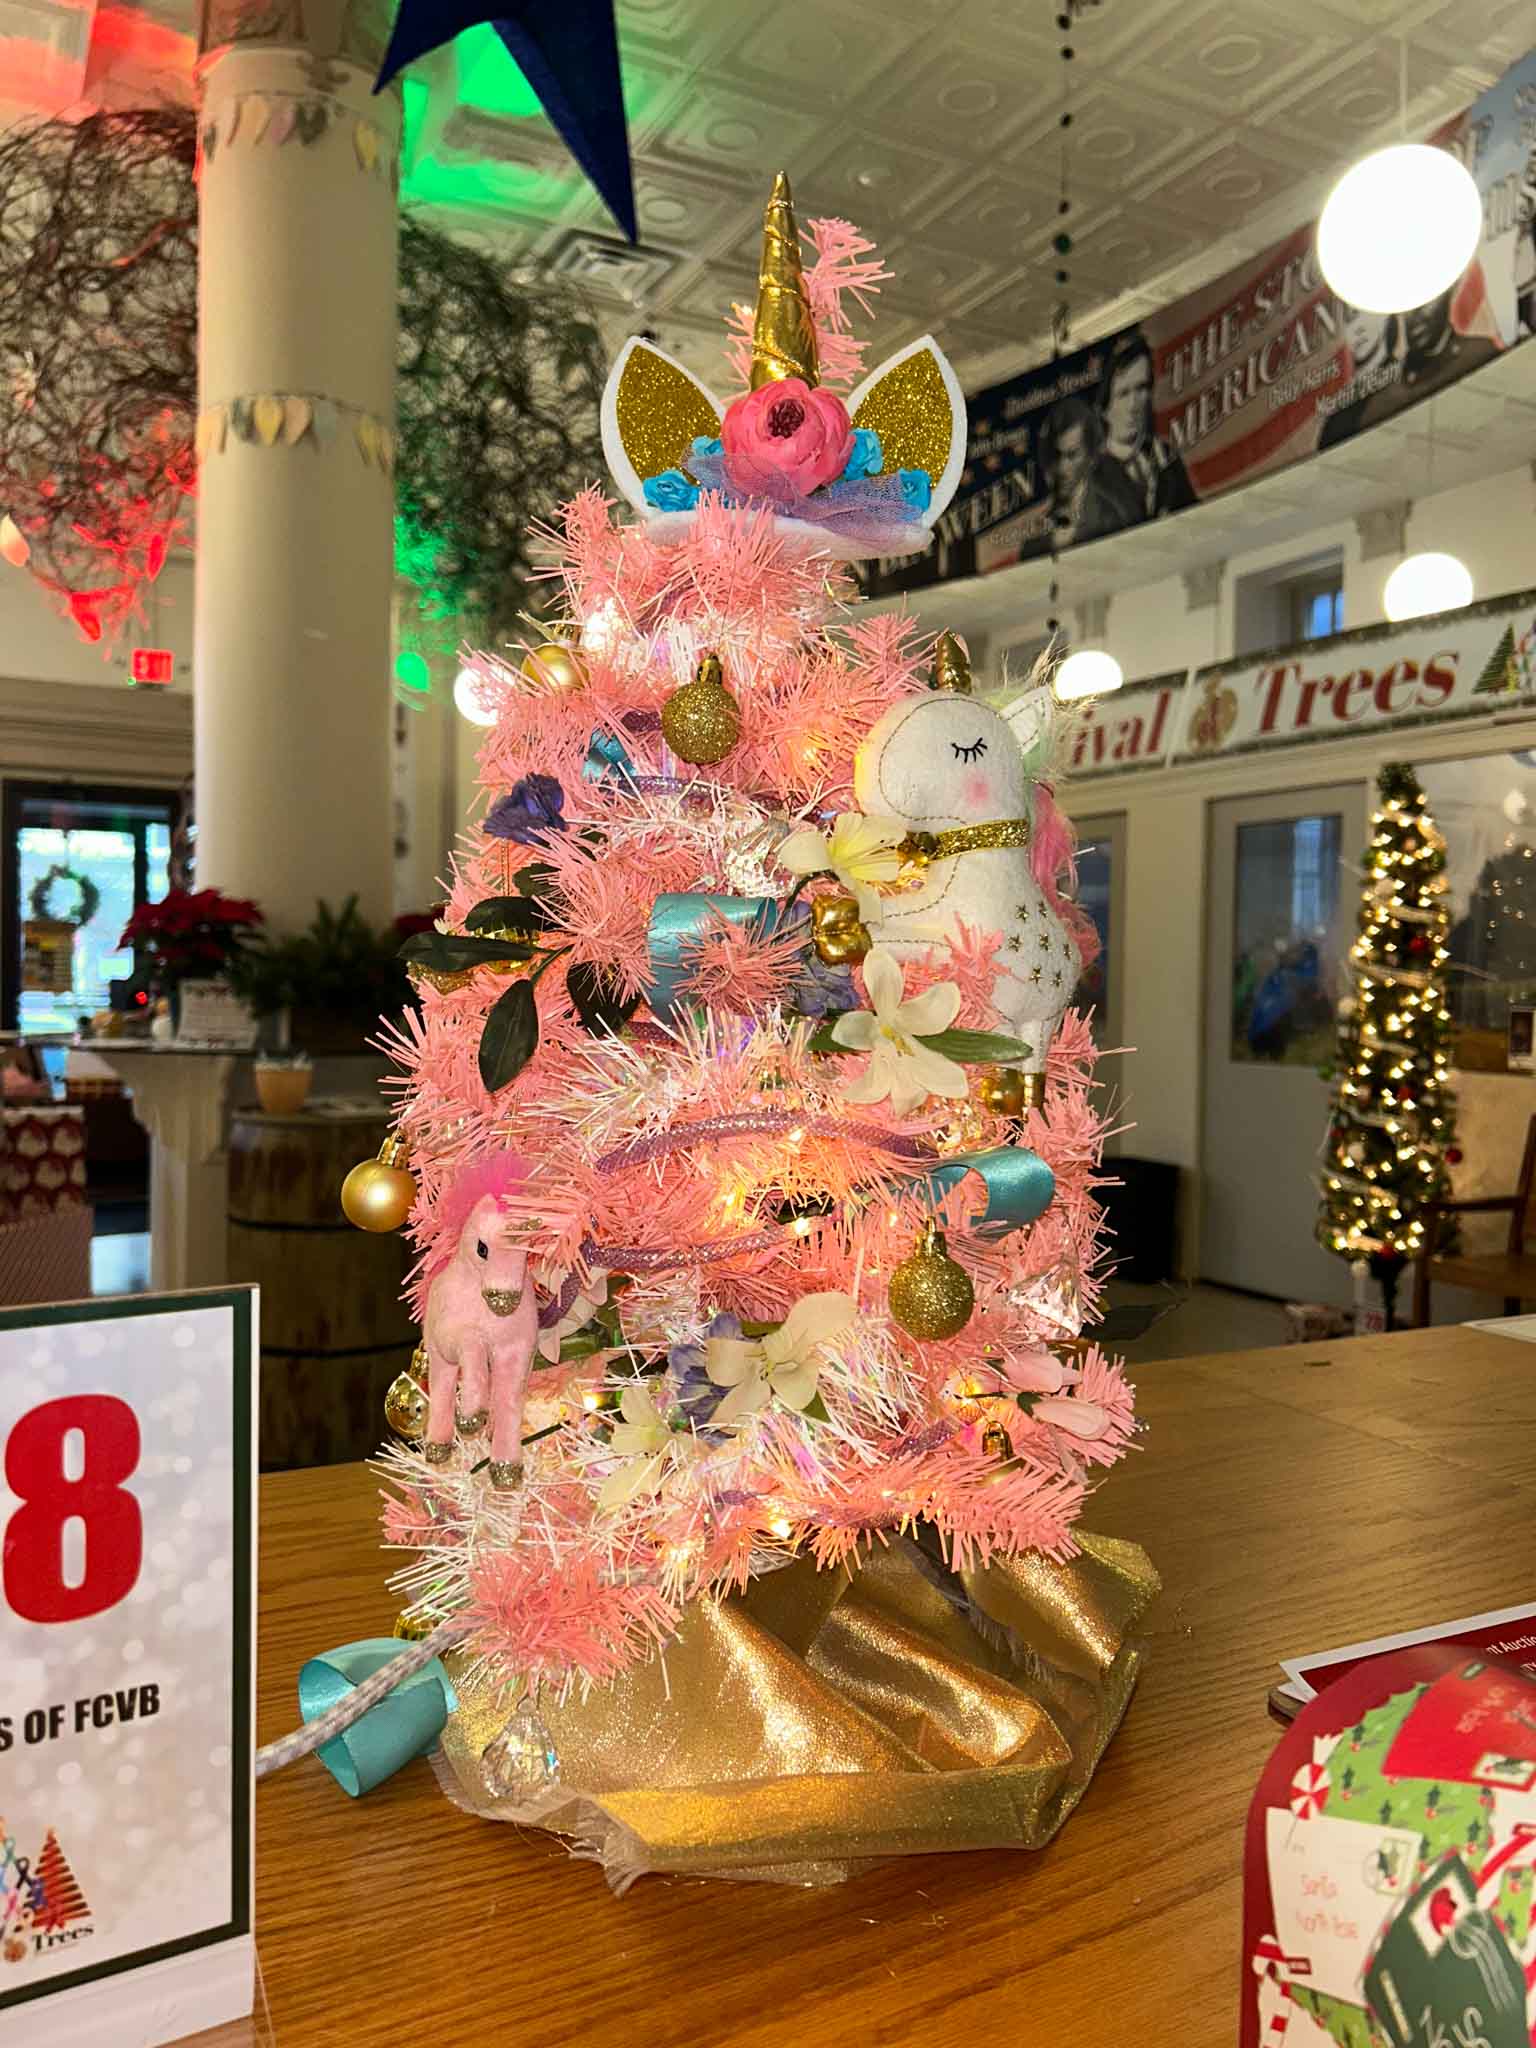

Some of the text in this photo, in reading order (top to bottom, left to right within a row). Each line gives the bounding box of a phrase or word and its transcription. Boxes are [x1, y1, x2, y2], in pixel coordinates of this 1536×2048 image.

[1165, 301, 1243, 393] THE
[1256, 651, 1460, 735] Trees
[3, 1393, 142, 1623] 8
[24, 1704, 65, 1744] OF
[75, 1683, 160, 1733] FCVB
